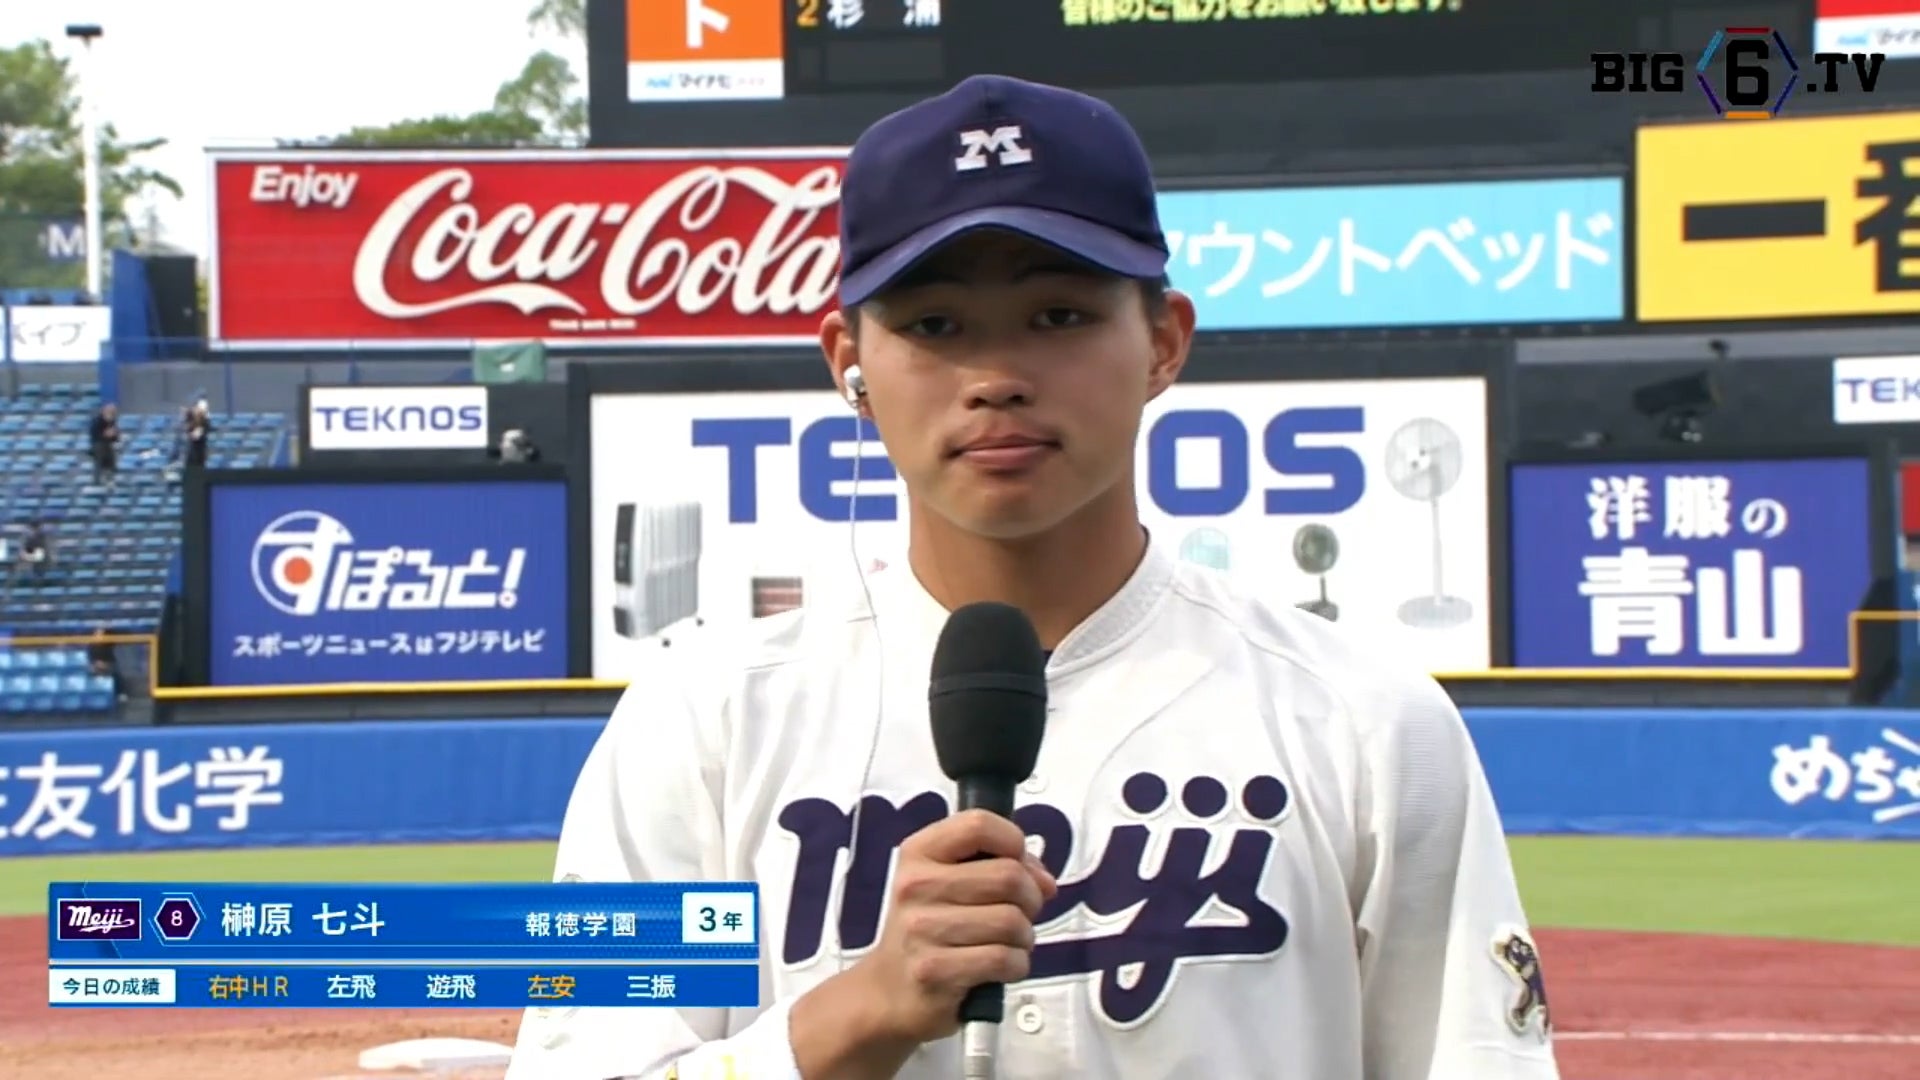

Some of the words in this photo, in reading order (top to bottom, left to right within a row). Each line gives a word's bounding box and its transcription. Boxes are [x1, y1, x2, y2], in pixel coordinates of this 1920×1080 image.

[797, 0, 819, 26] 2
[955, 125, 1032, 171] M
[250, 166, 358, 207] Enjoy
[353, 167, 839, 318] Coca-Cola
[1163, 210, 1614, 298] ウントベッド
[315, 405, 482, 431] TEKNOS
[691, 406, 1366, 523] TEOS
[1585, 475, 1788, 540] 洋服の
[1578, 547, 1803, 656] 青山
[0, 746, 284, 839] 友化学
